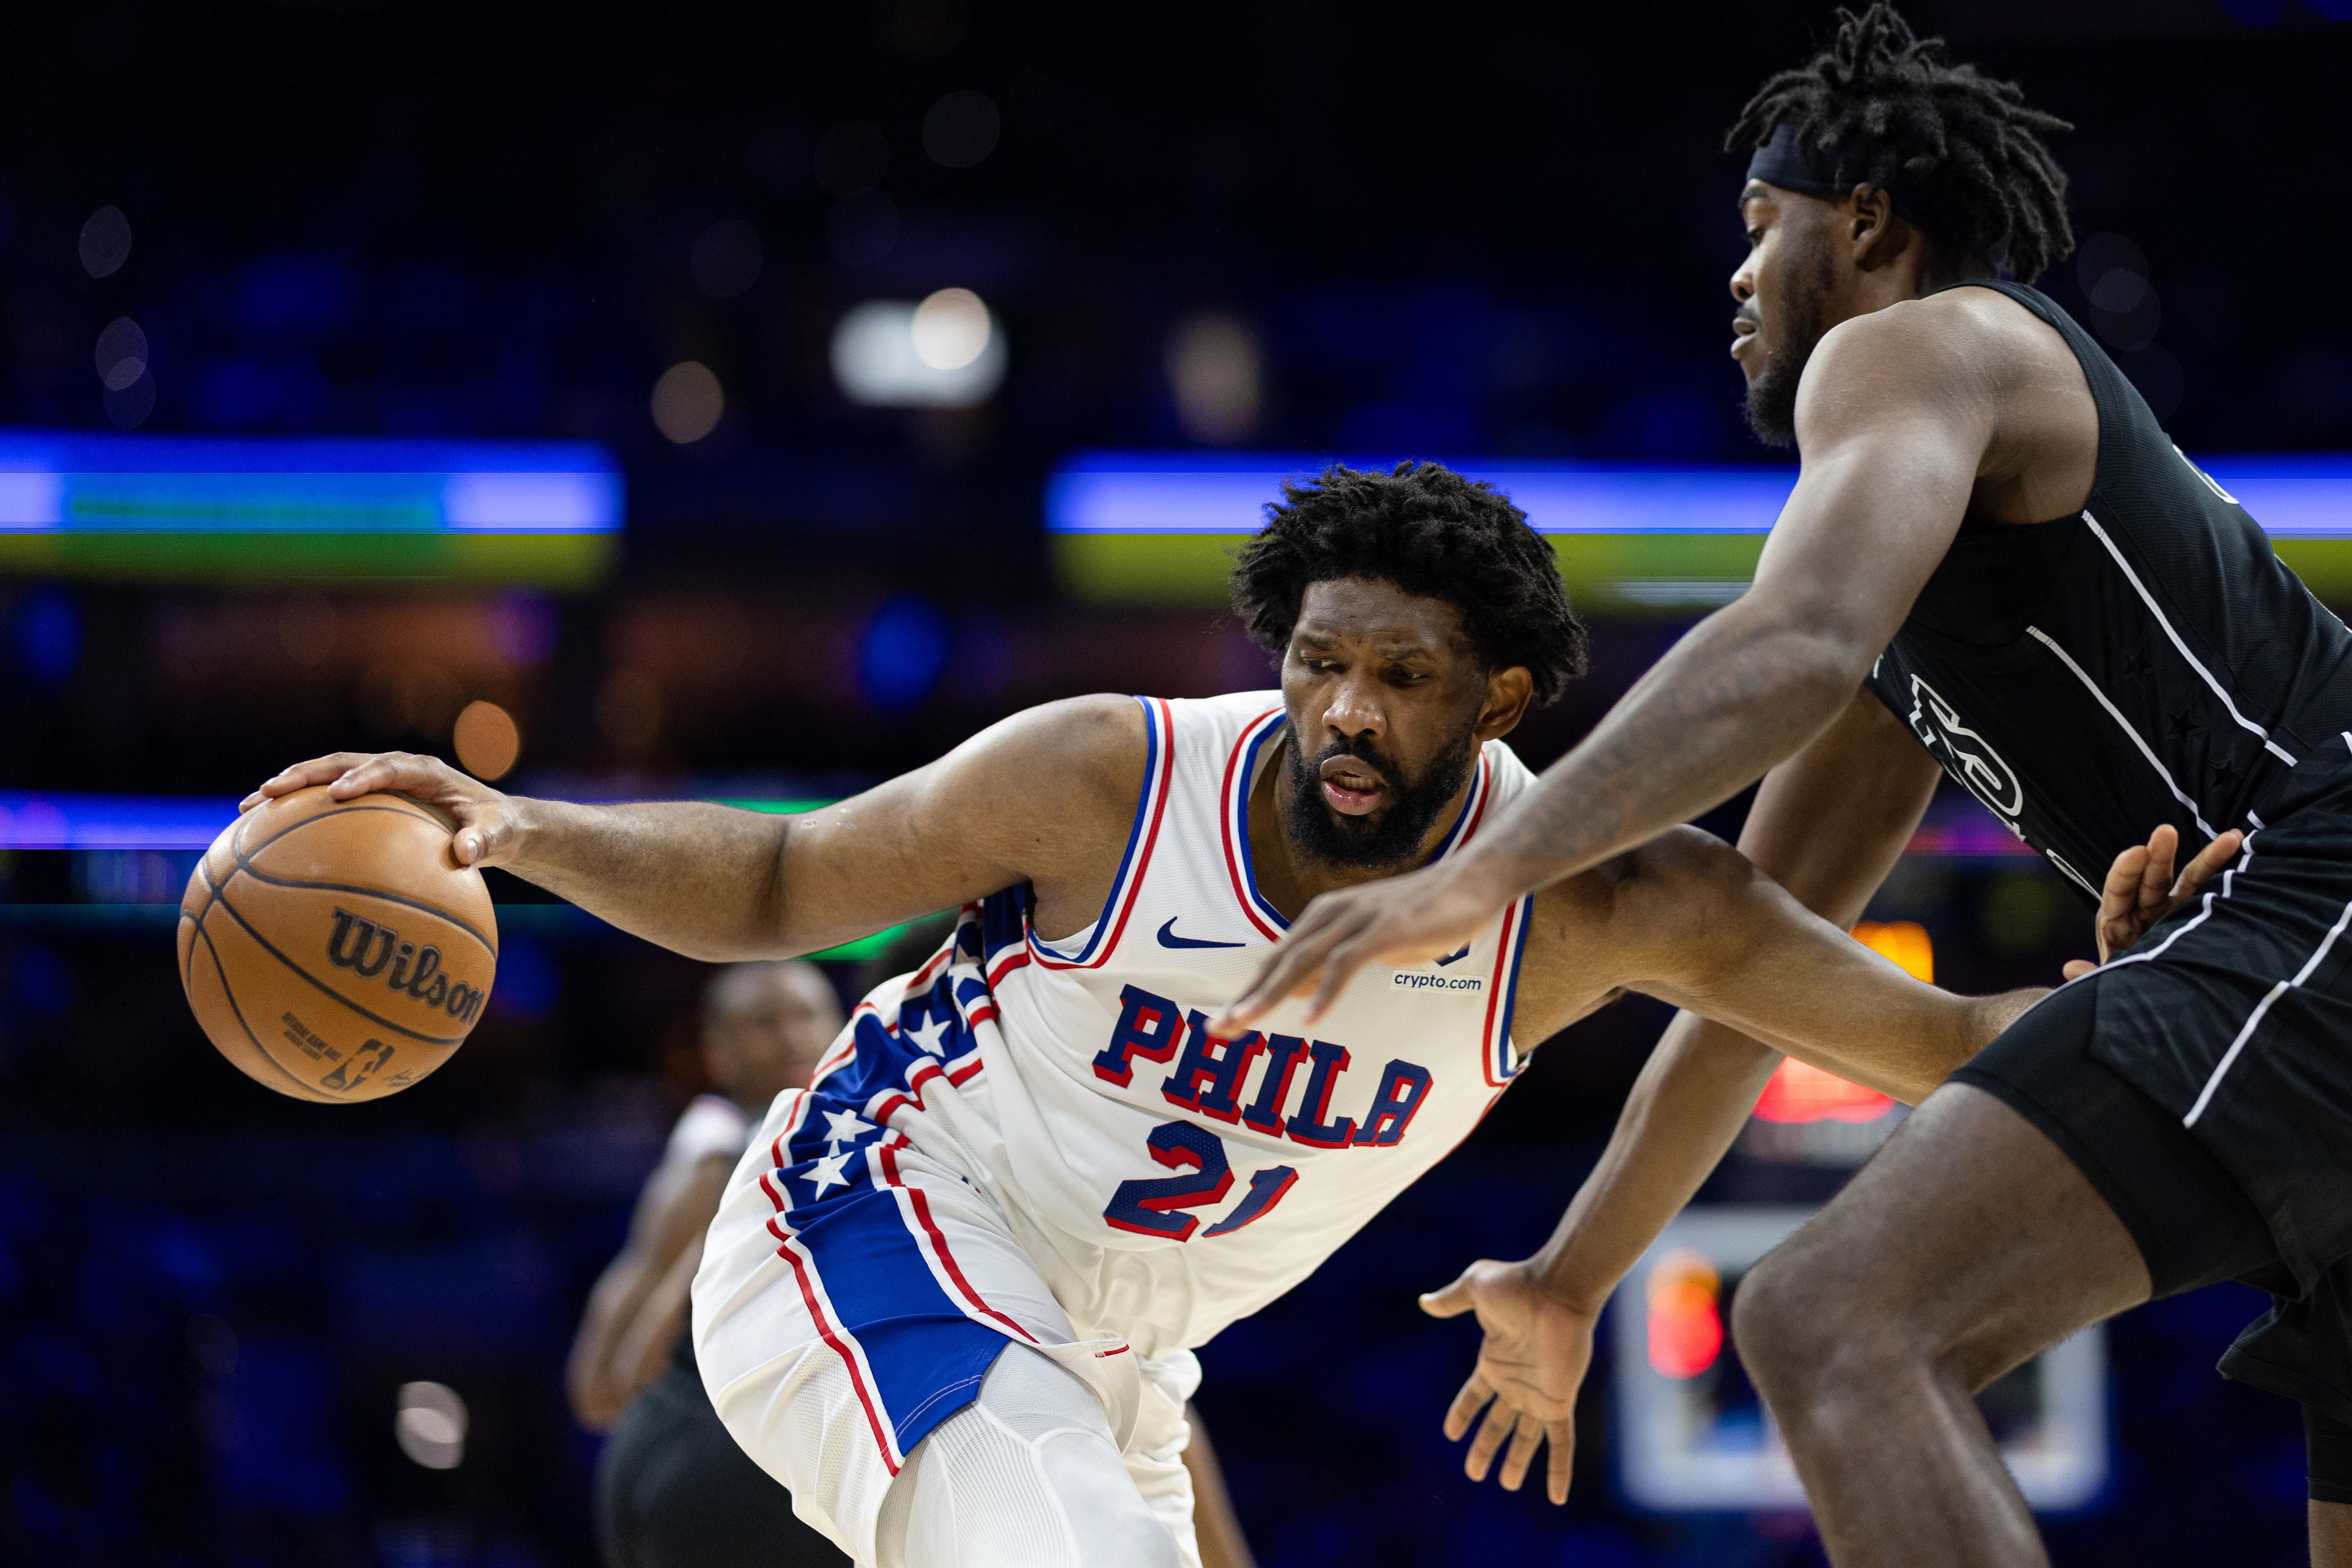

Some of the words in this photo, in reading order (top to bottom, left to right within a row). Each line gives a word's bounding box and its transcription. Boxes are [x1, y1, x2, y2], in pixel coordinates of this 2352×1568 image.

[327, 907, 485, 1025] Wilson
[1394, 974, 1482, 991] crypto.com
[1092, 983, 1433, 1149] PHILA
[1103, 1120, 1299, 1243] 21
